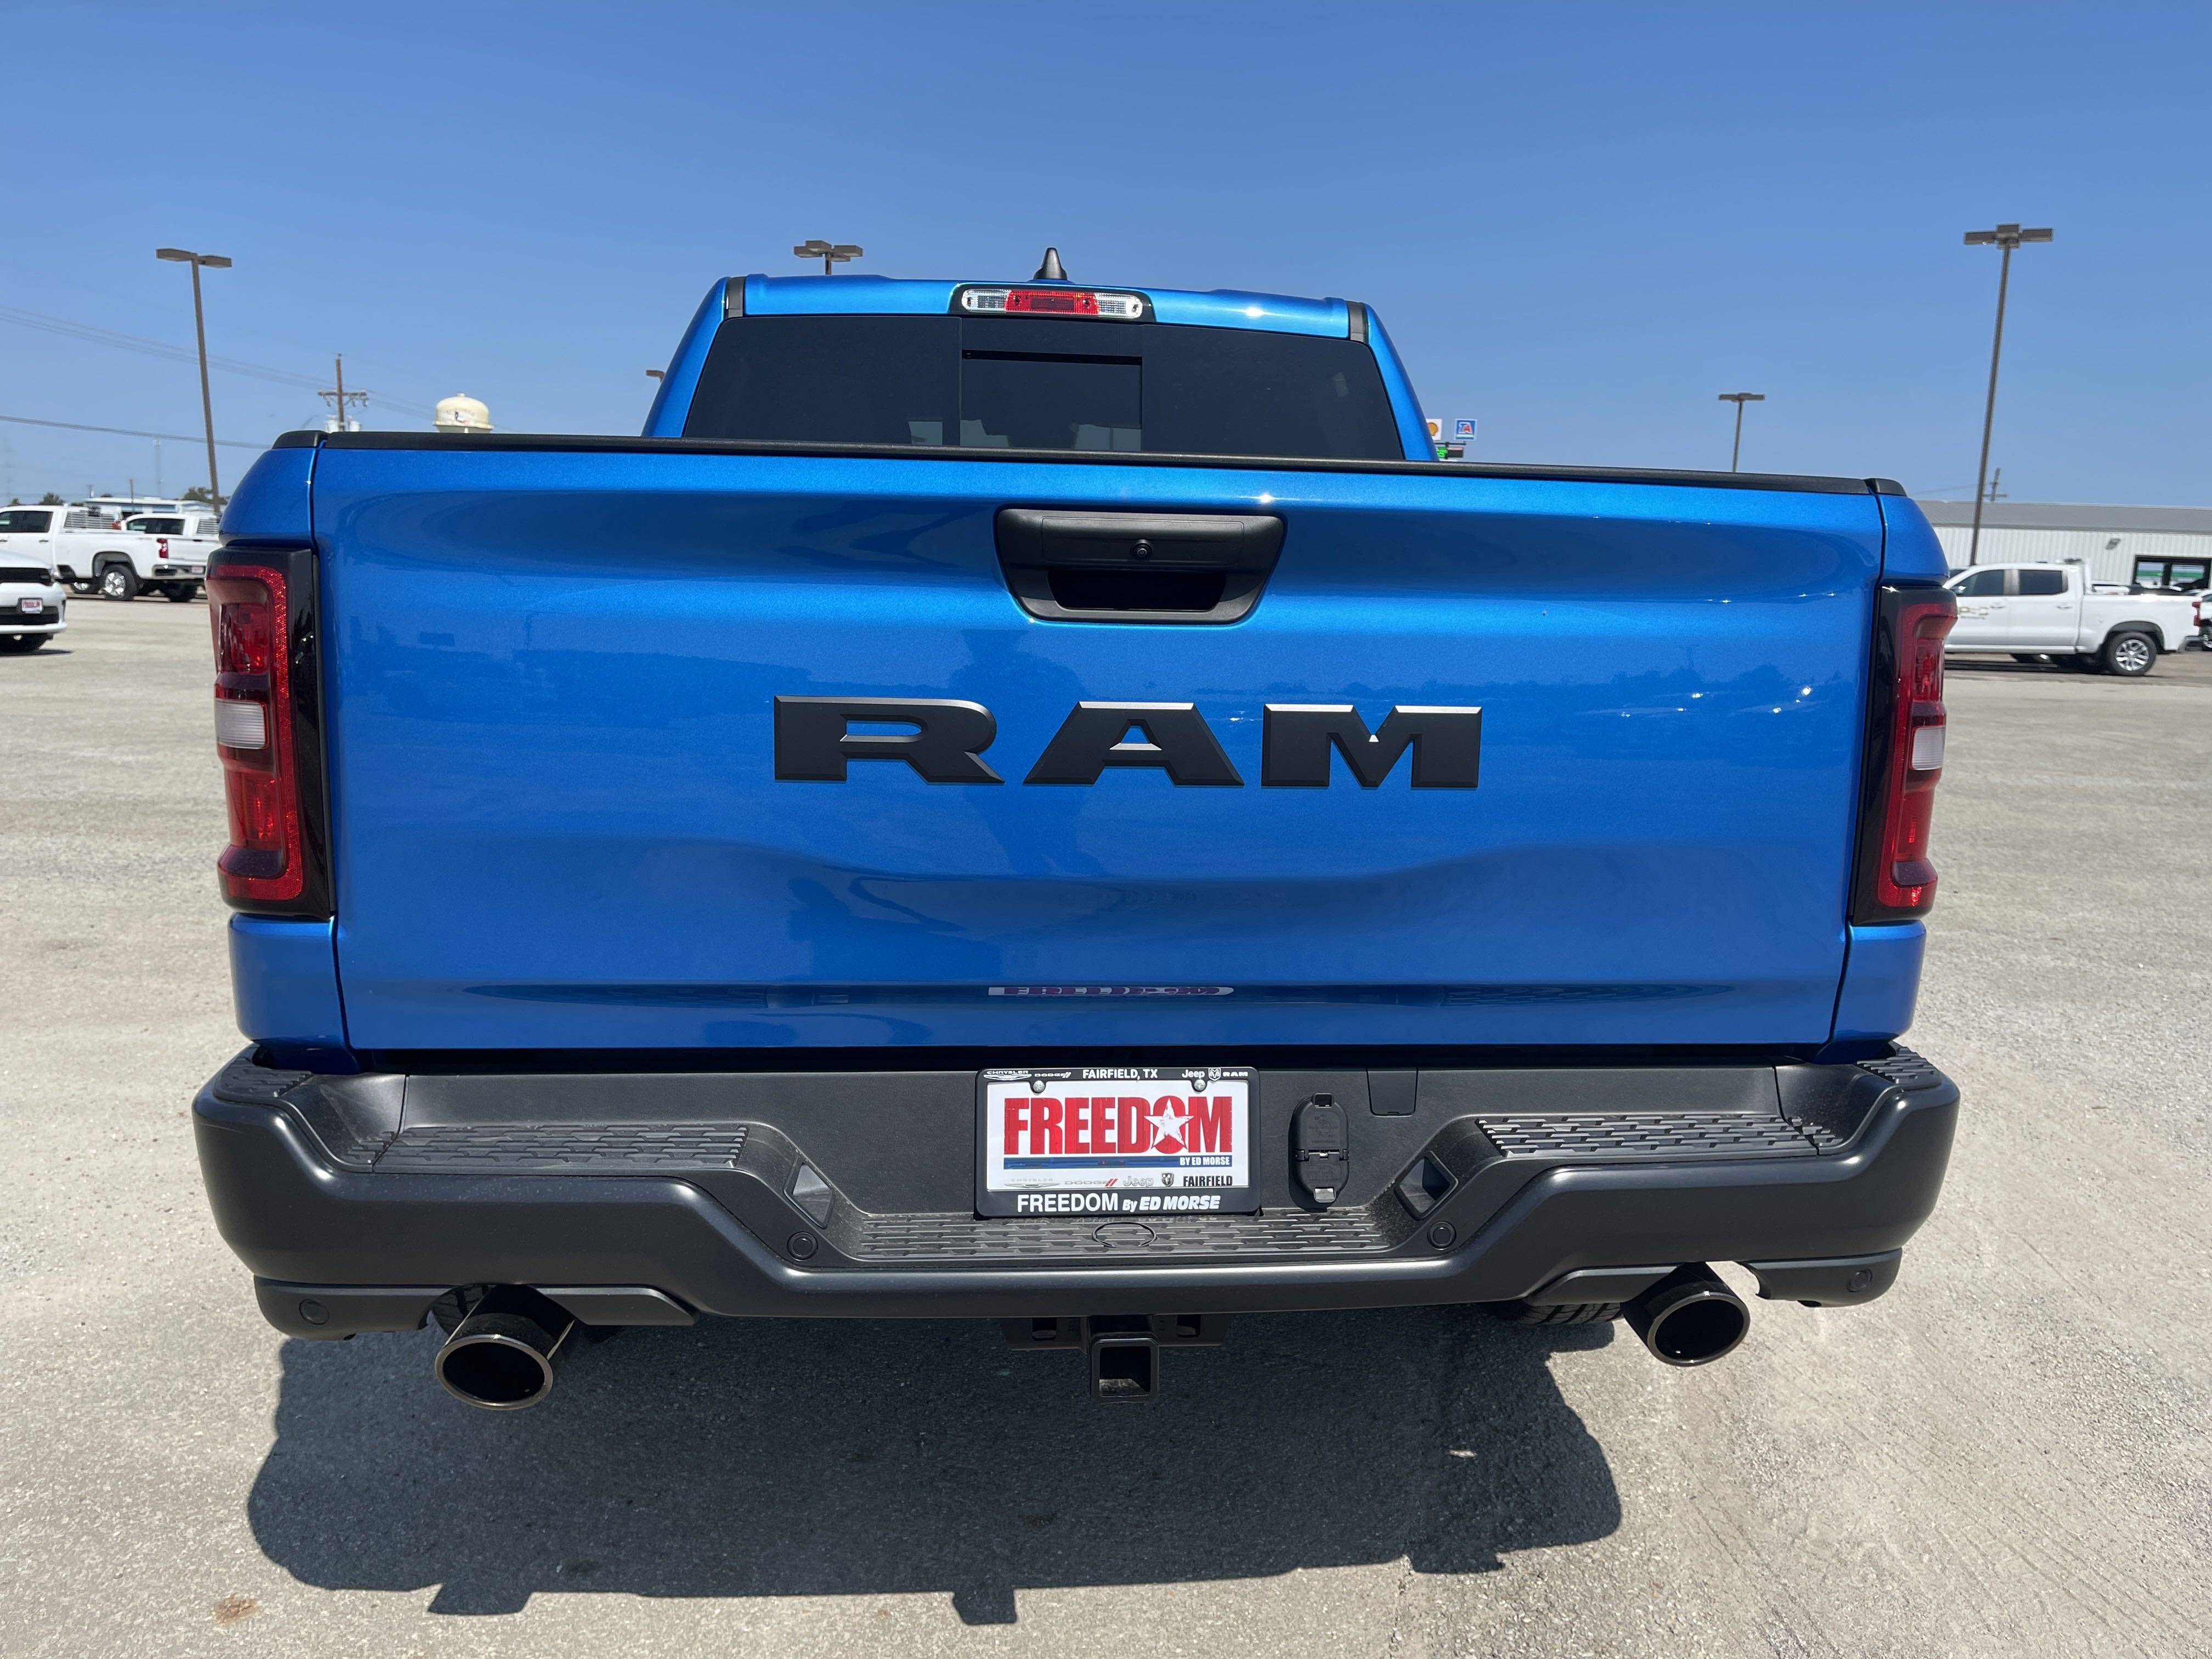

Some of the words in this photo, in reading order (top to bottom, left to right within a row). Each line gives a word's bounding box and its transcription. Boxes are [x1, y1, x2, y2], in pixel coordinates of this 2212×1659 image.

[774, 695, 1483, 788] RAM
[1082, 1069, 1140, 1080] FAIRFIELD,
[1143, 1069, 1158, 1079] TX
[1182, 1069, 1205, 1079] Jeep
[1005, 1096, 1232, 1154] FREEDOM
[1180, 1157, 1190, 1166] BY
[1192, 1157, 1201, 1165] ED
[1203, 1156, 1230, 1165] MORSE
[1123, 1176, 1154, 1187] Jeep
[1183, 1176, 1233, 1187] FAIRFIELD
[1017, 1193, 1118, 1212] FREEDOM
[1122, 1199, 1138, 1212] By
[1139, 1196, 1161, 1210] ED
[1163, 1195, 1221, 1210] MORSE
